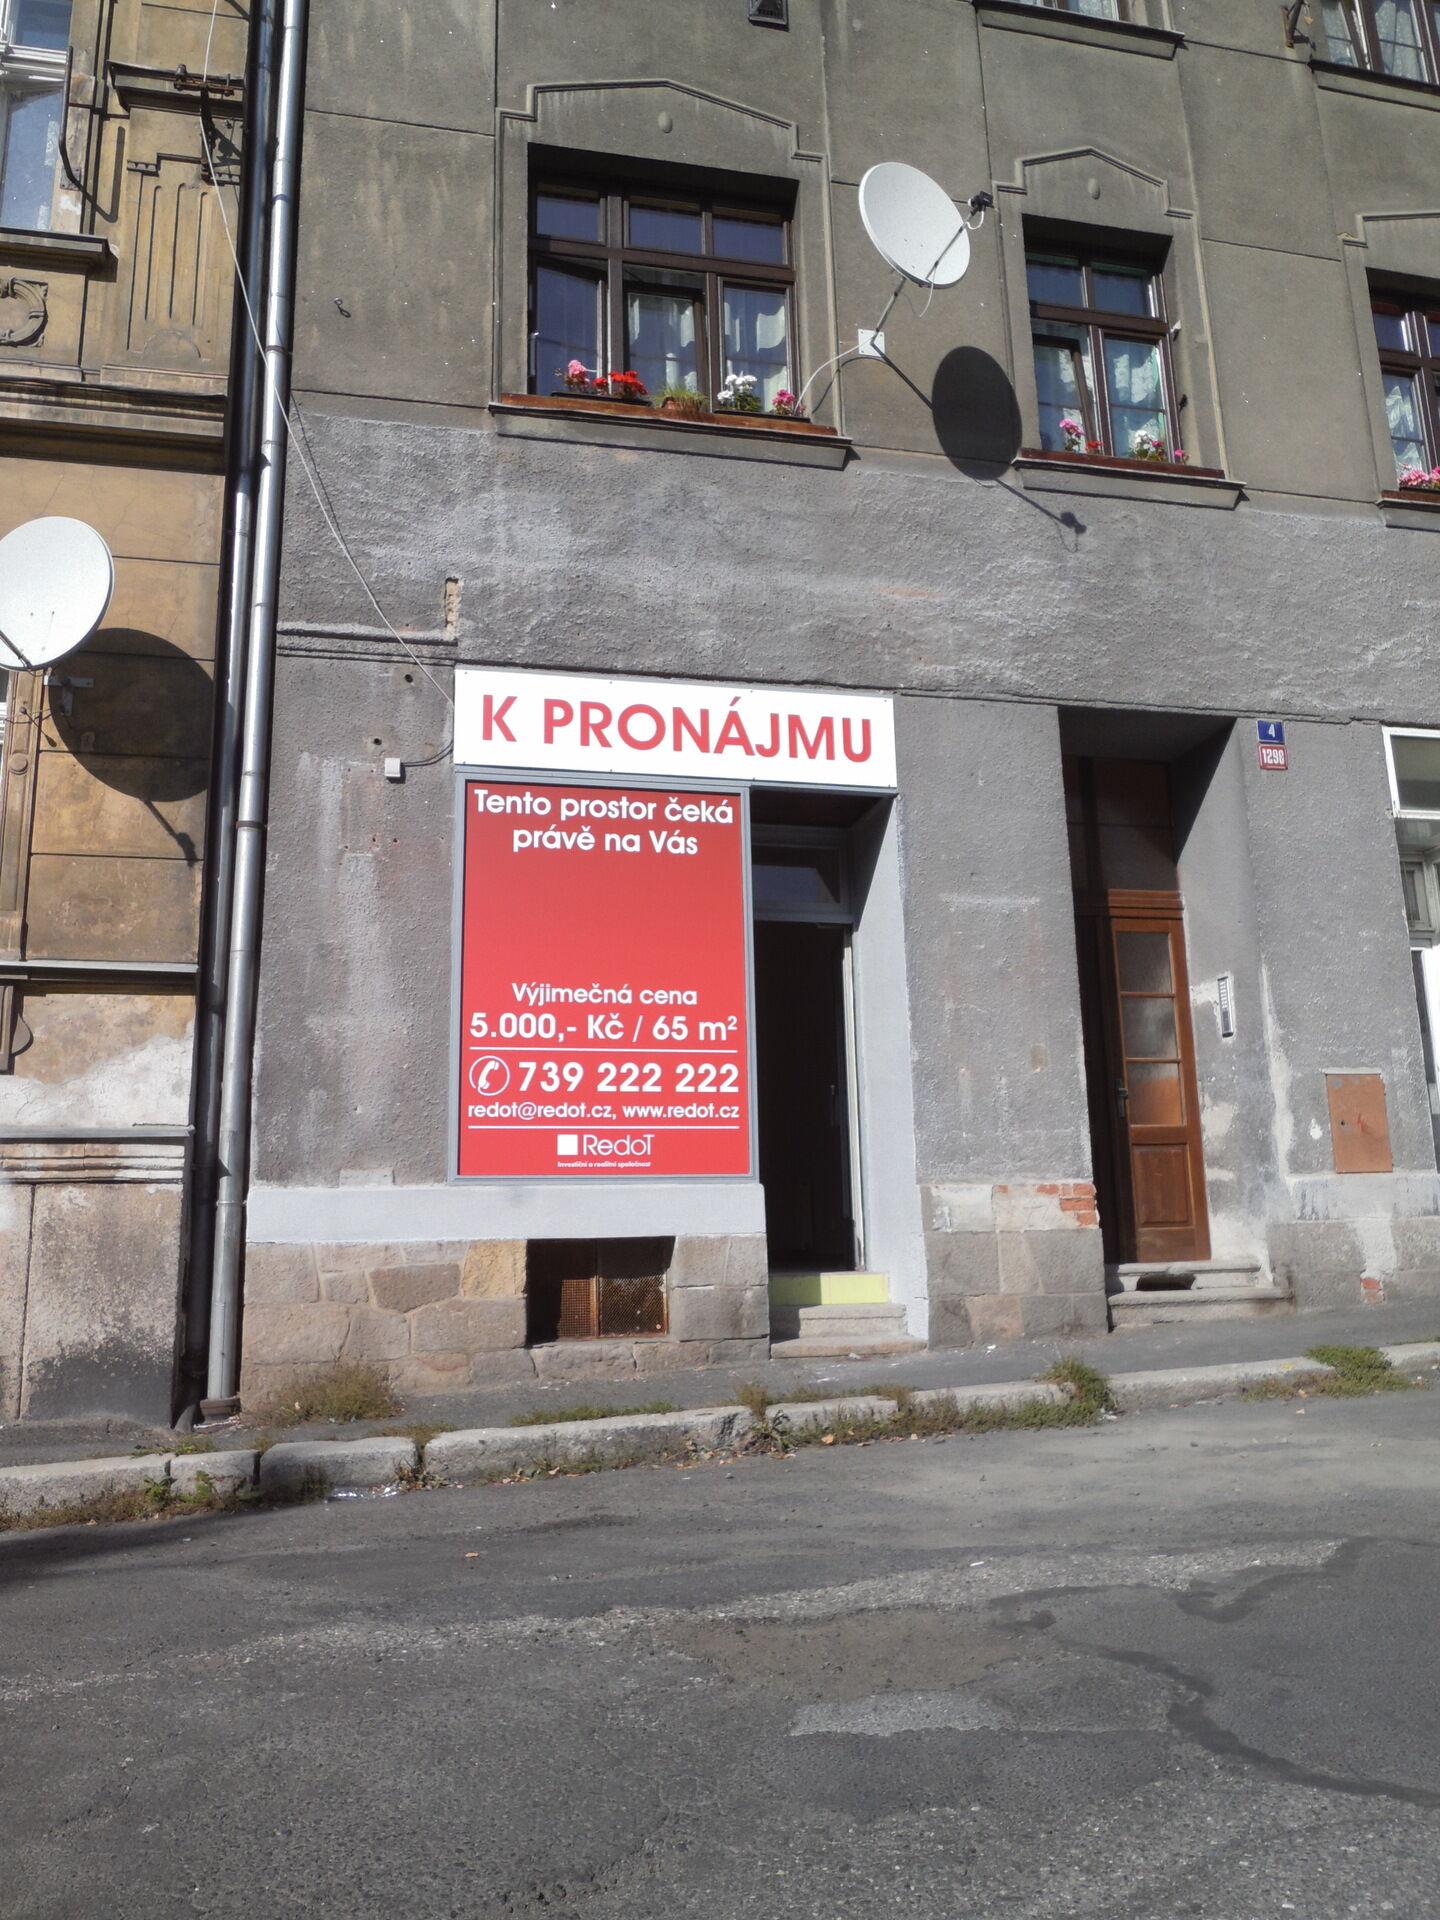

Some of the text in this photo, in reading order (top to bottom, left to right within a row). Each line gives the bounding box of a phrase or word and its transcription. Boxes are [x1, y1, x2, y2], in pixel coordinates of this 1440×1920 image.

[482, 694, 872, 763] K PRONÁJMU
[1268, 723, 1276, 738] 4
[474, 789, 733, 823] Tento prostor čeká
[512, 826, 698, 854] právě na Vás
[512, 982, 697, 1006] Výjimečná cena
[469, 1011, 577, 1042] 5.000,-
[588, 1013, 624, 1039] Kč
[633, 1016, 642, 1042] /
[653, 1016, 688, 1040] 65
[519, 1062, 738, 1092] 739 222 222
[468, 1102, 739, 1120] redot@redot.cz, www.redot.cz
